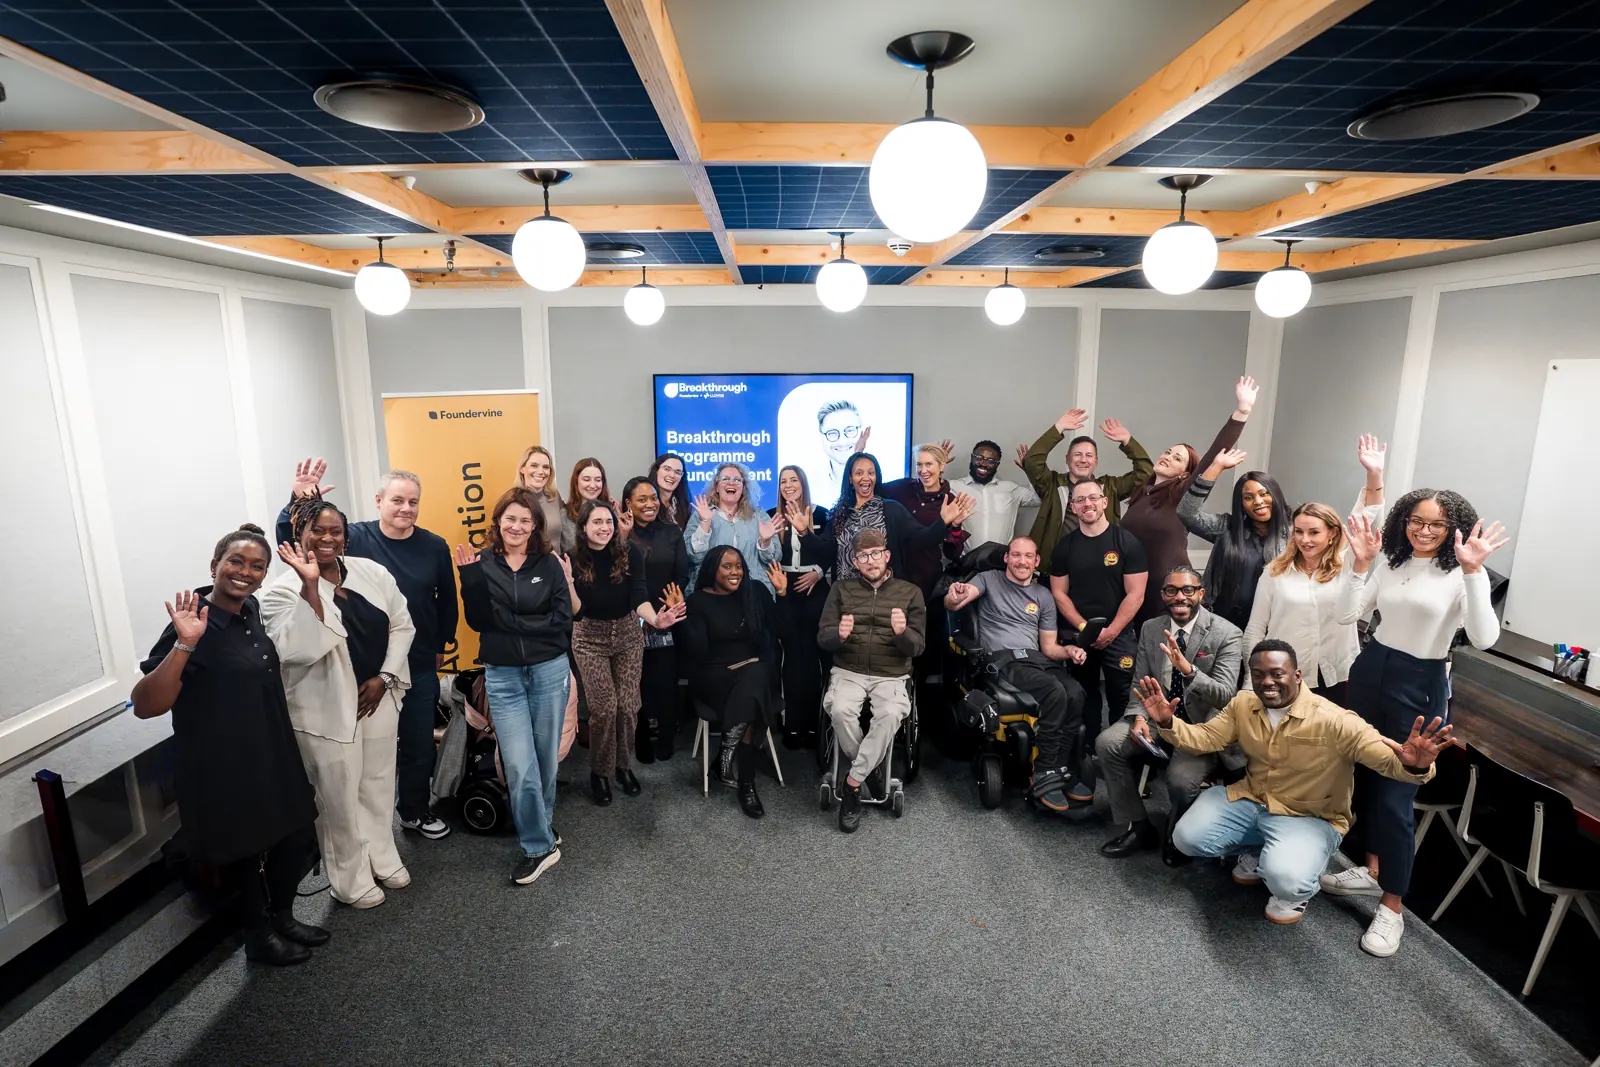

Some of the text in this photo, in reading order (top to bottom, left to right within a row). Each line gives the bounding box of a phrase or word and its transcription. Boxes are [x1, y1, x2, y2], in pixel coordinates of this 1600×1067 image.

[679, 382, 747, 394] Breakthrough
[440, 408, 503, 420] Foundervine
[666, 430, 771, 446] Breakthrough
